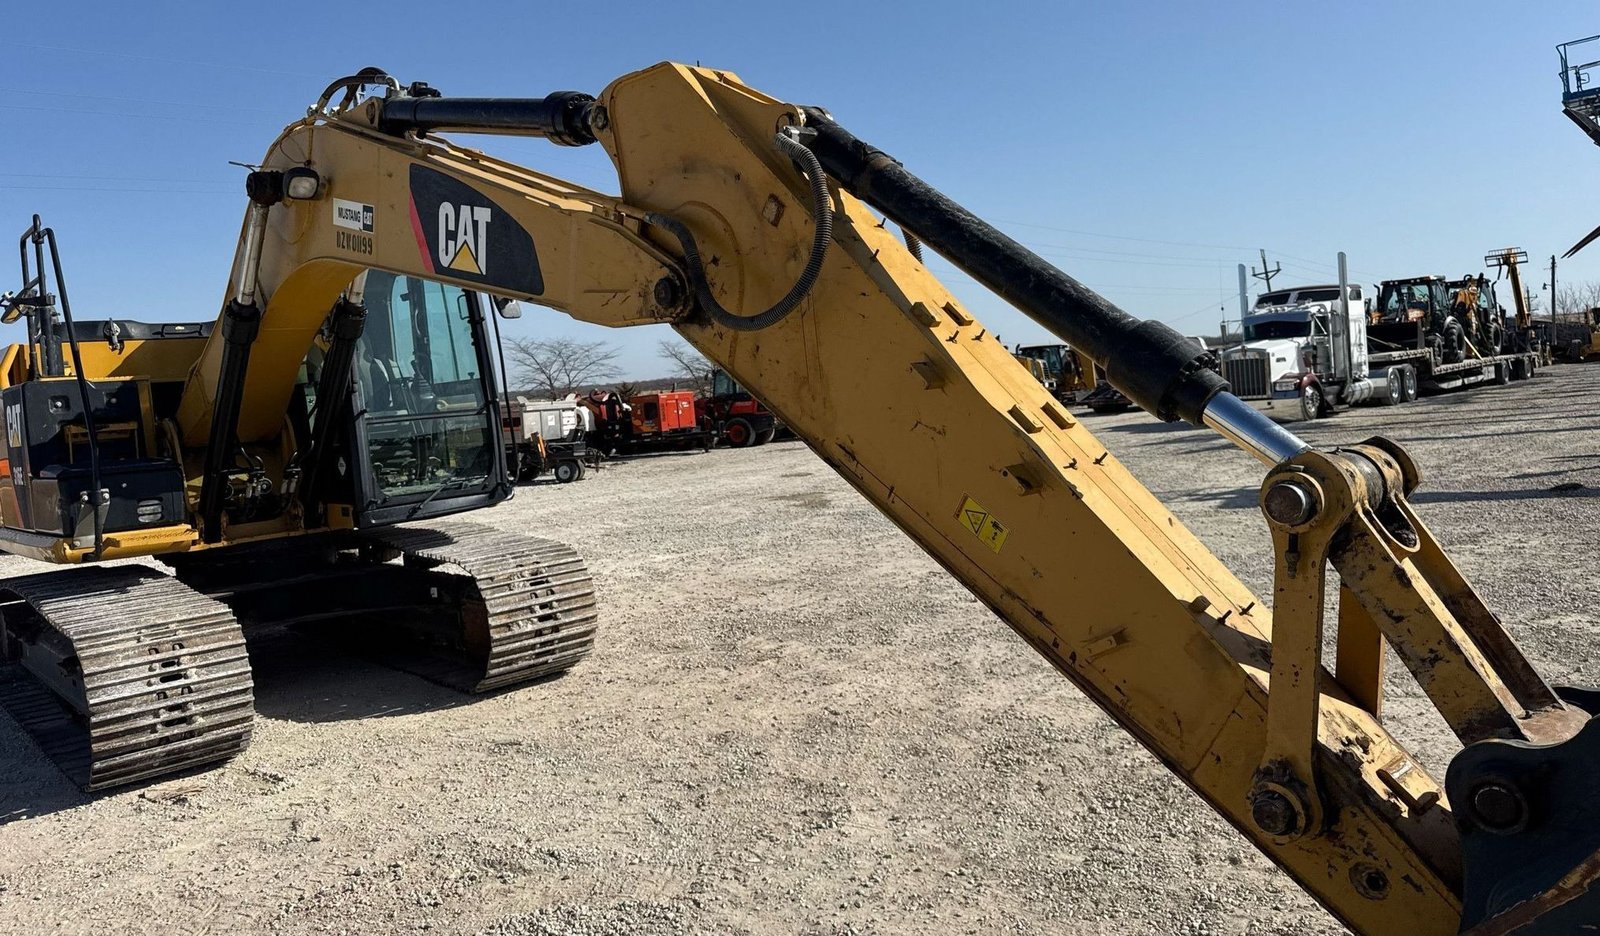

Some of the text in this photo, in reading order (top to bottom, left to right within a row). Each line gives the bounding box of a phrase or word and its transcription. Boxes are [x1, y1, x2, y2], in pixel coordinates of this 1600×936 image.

[338, 206, 361, 223] MUSTANG
[438, 201, 491, 275] CAT
[6, 403, 22, 448] CAT
